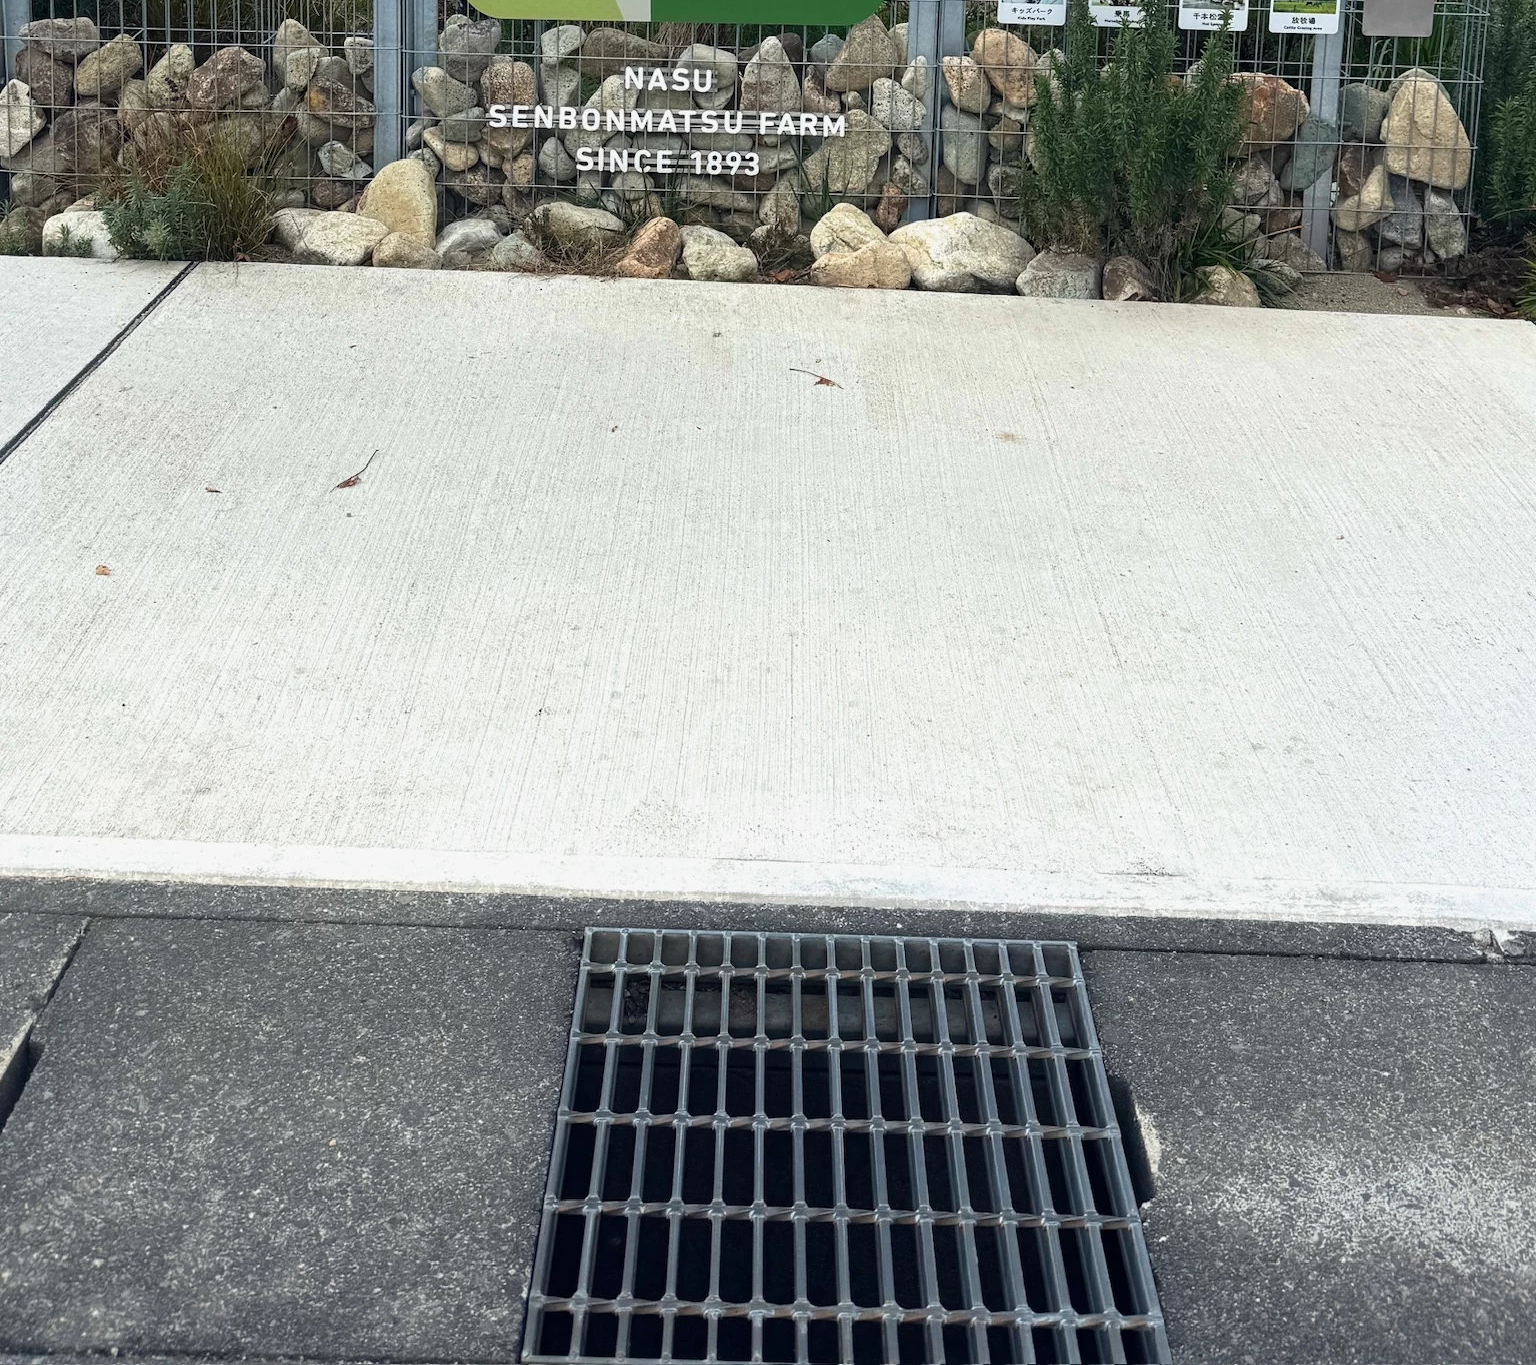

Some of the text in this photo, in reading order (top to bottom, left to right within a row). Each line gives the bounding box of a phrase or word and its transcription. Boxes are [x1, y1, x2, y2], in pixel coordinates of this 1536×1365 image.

[1292, 16, 1316, 24] 放牧場
[624, 66, 713, 92] NASU
[488, 104, 846, 138] SENBONMATSU FARM
[576, 146, 760, 176] SINCE 1893
